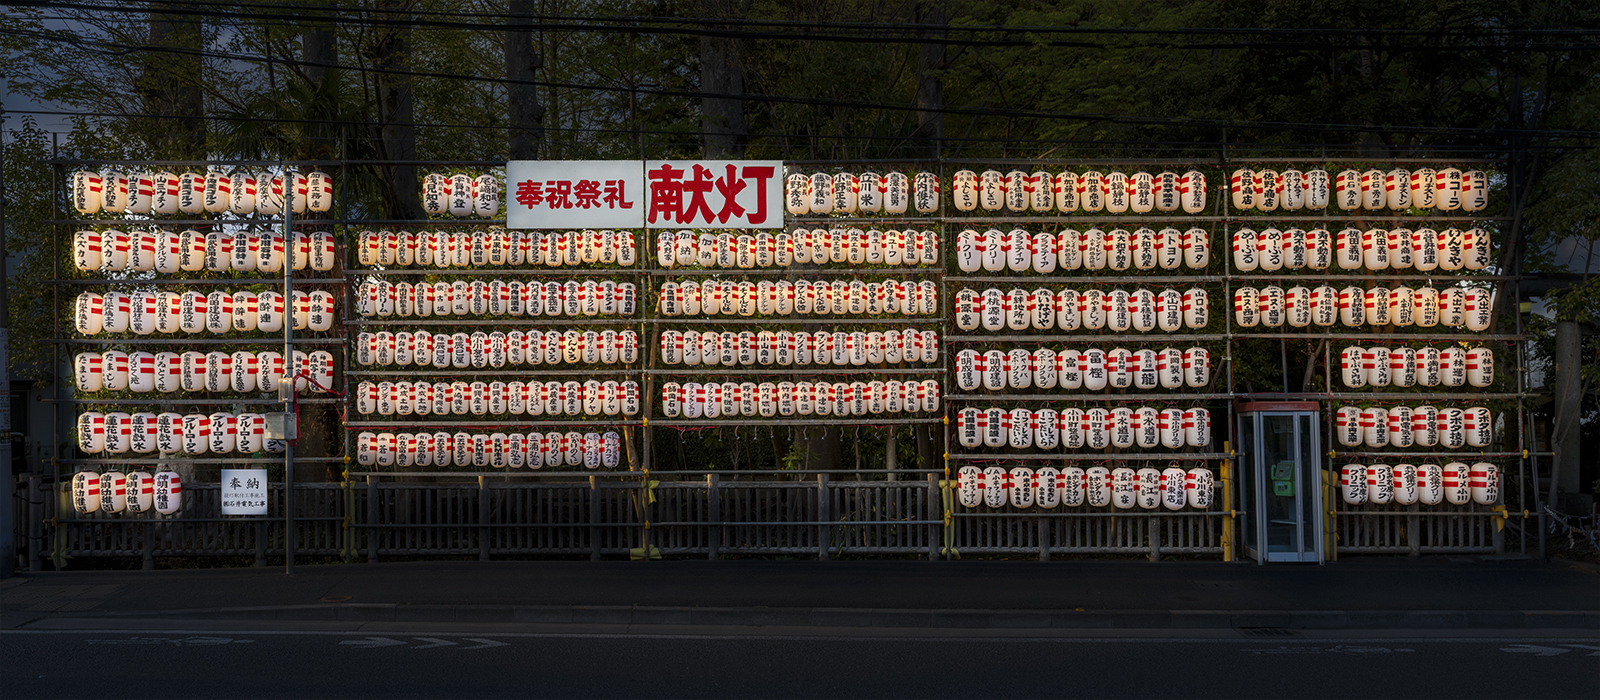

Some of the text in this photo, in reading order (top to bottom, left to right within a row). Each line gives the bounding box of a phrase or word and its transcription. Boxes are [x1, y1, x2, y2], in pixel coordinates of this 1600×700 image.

[515, 179, 633, 209] 奉祝祭礼
[647, 164, 775, 224] 献灯
[77, 233, 87, 267] スズカメ
[104, 232, 114, 268] スズカメ
[679, 233, 691, 255] 加納
[701, 239, 712, 259] 加納
[1241, 233, 1255, 263] めーぷる
[1268, 232, 1282, 265] めーぷる
[79, 355, 88, 390] たましん
[106, 353, 116, 388] たましん
[588, 383, 596, 412] モリタヤ
[607, 383, 615, 411] モリタヤ
[213, 415, 225, 451] ブルーロータス
[240, 416, 251, 452] ブルーロータス
[101, 475, 114, 511] 神明幼稚園
[127, 474, 140, 511] 神明幼稚園
[157, 474, 169, 509] 神明幼稚園
[230, 477, 260, 490] 奉納
[1350, 469, 1359, 498] クリニック
[1377, 469, 1386, 499] クリニック
